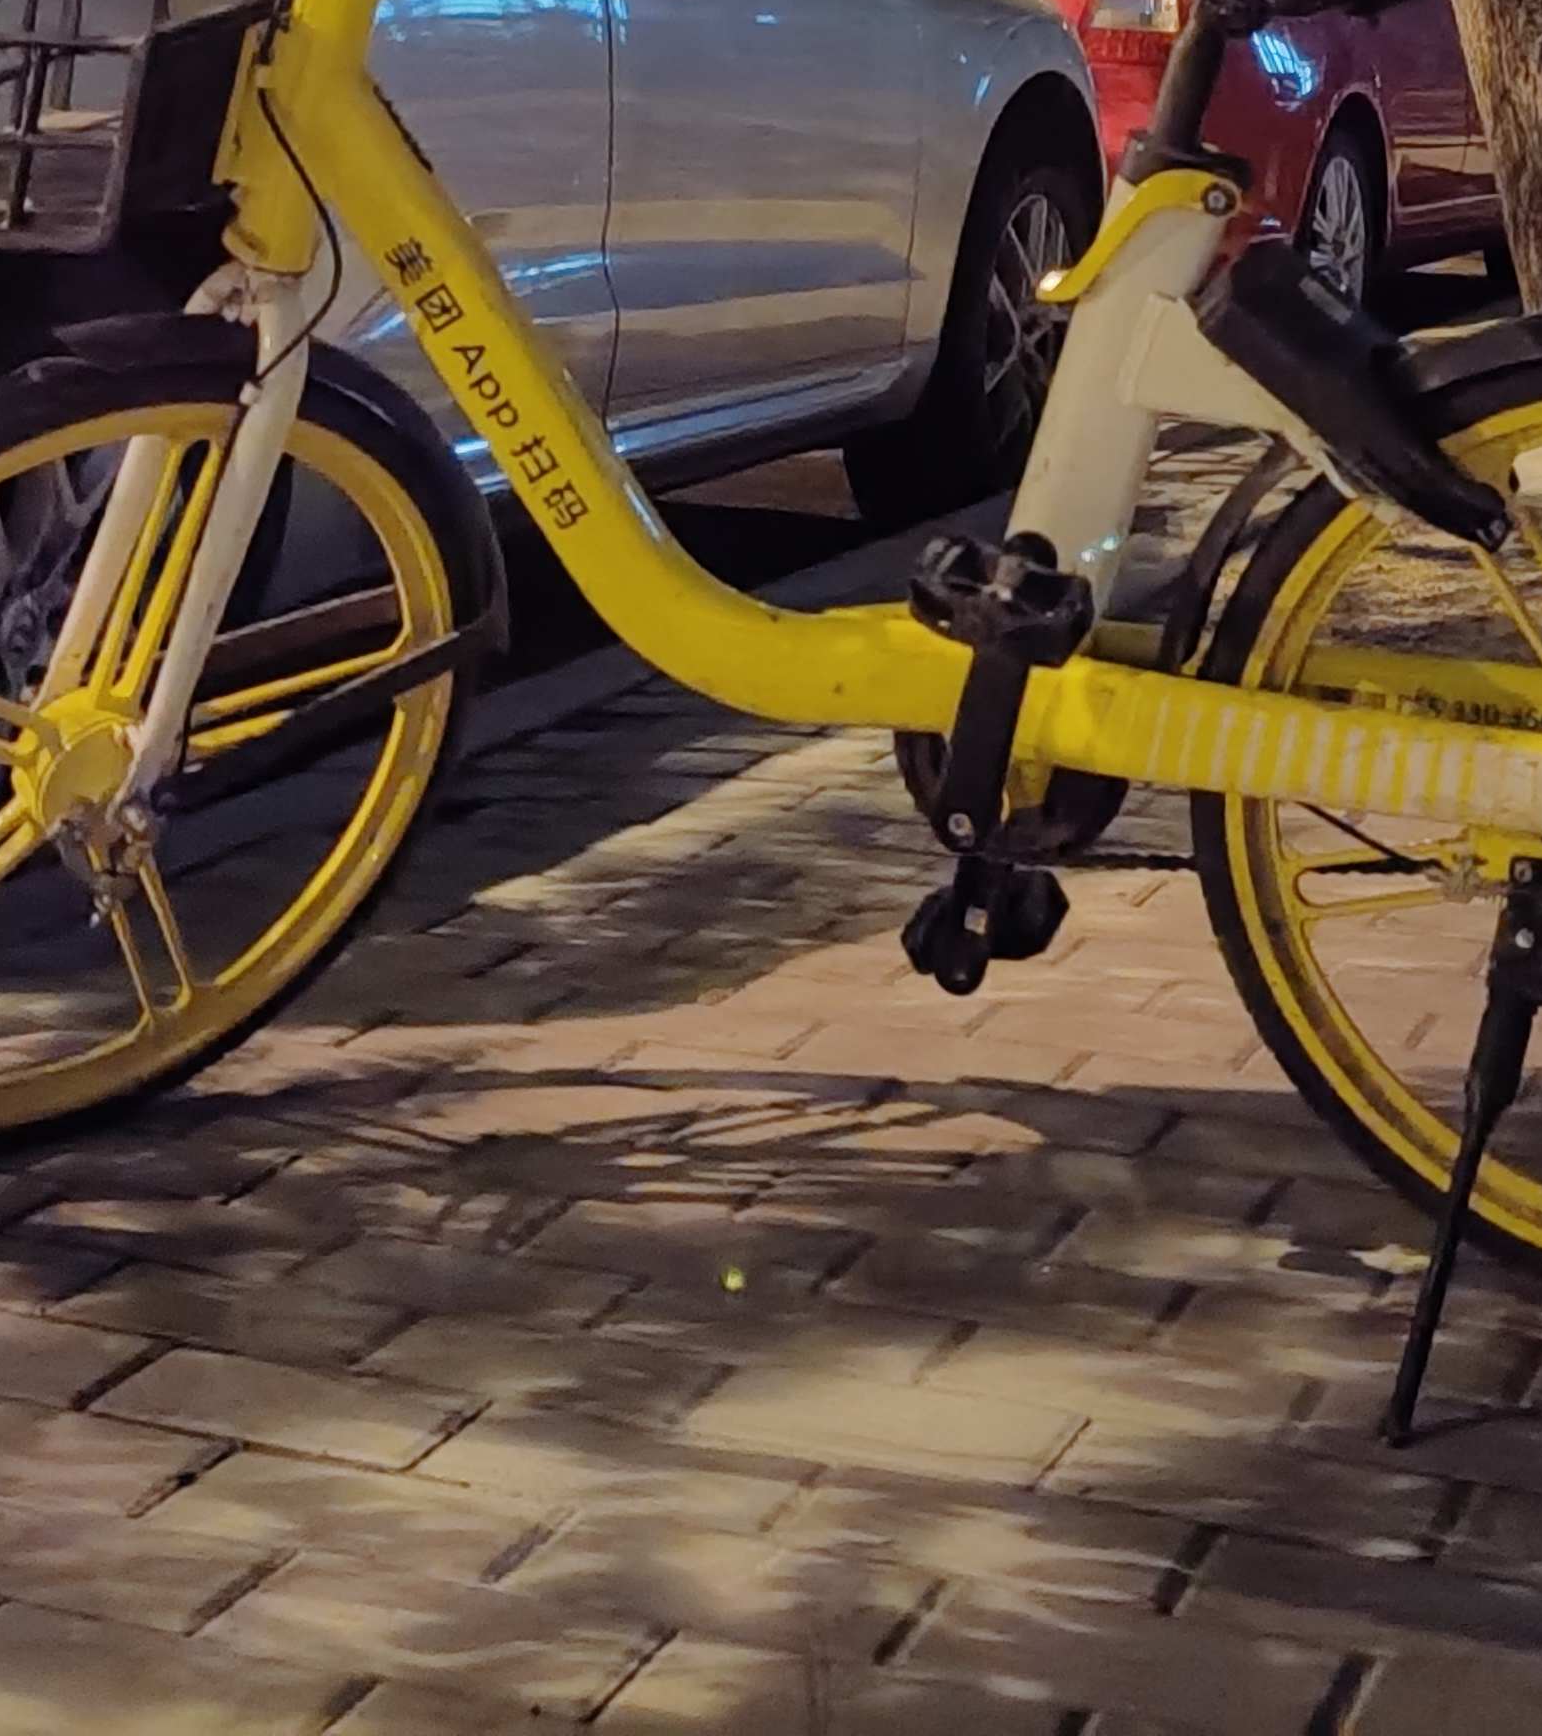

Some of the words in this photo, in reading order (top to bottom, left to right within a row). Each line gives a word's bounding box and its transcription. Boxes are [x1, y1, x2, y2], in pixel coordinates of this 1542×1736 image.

[384, 237, 466, 333] 美团
[452, 344, 520, 430] App
[510, 433, 590, 530] 扫码
